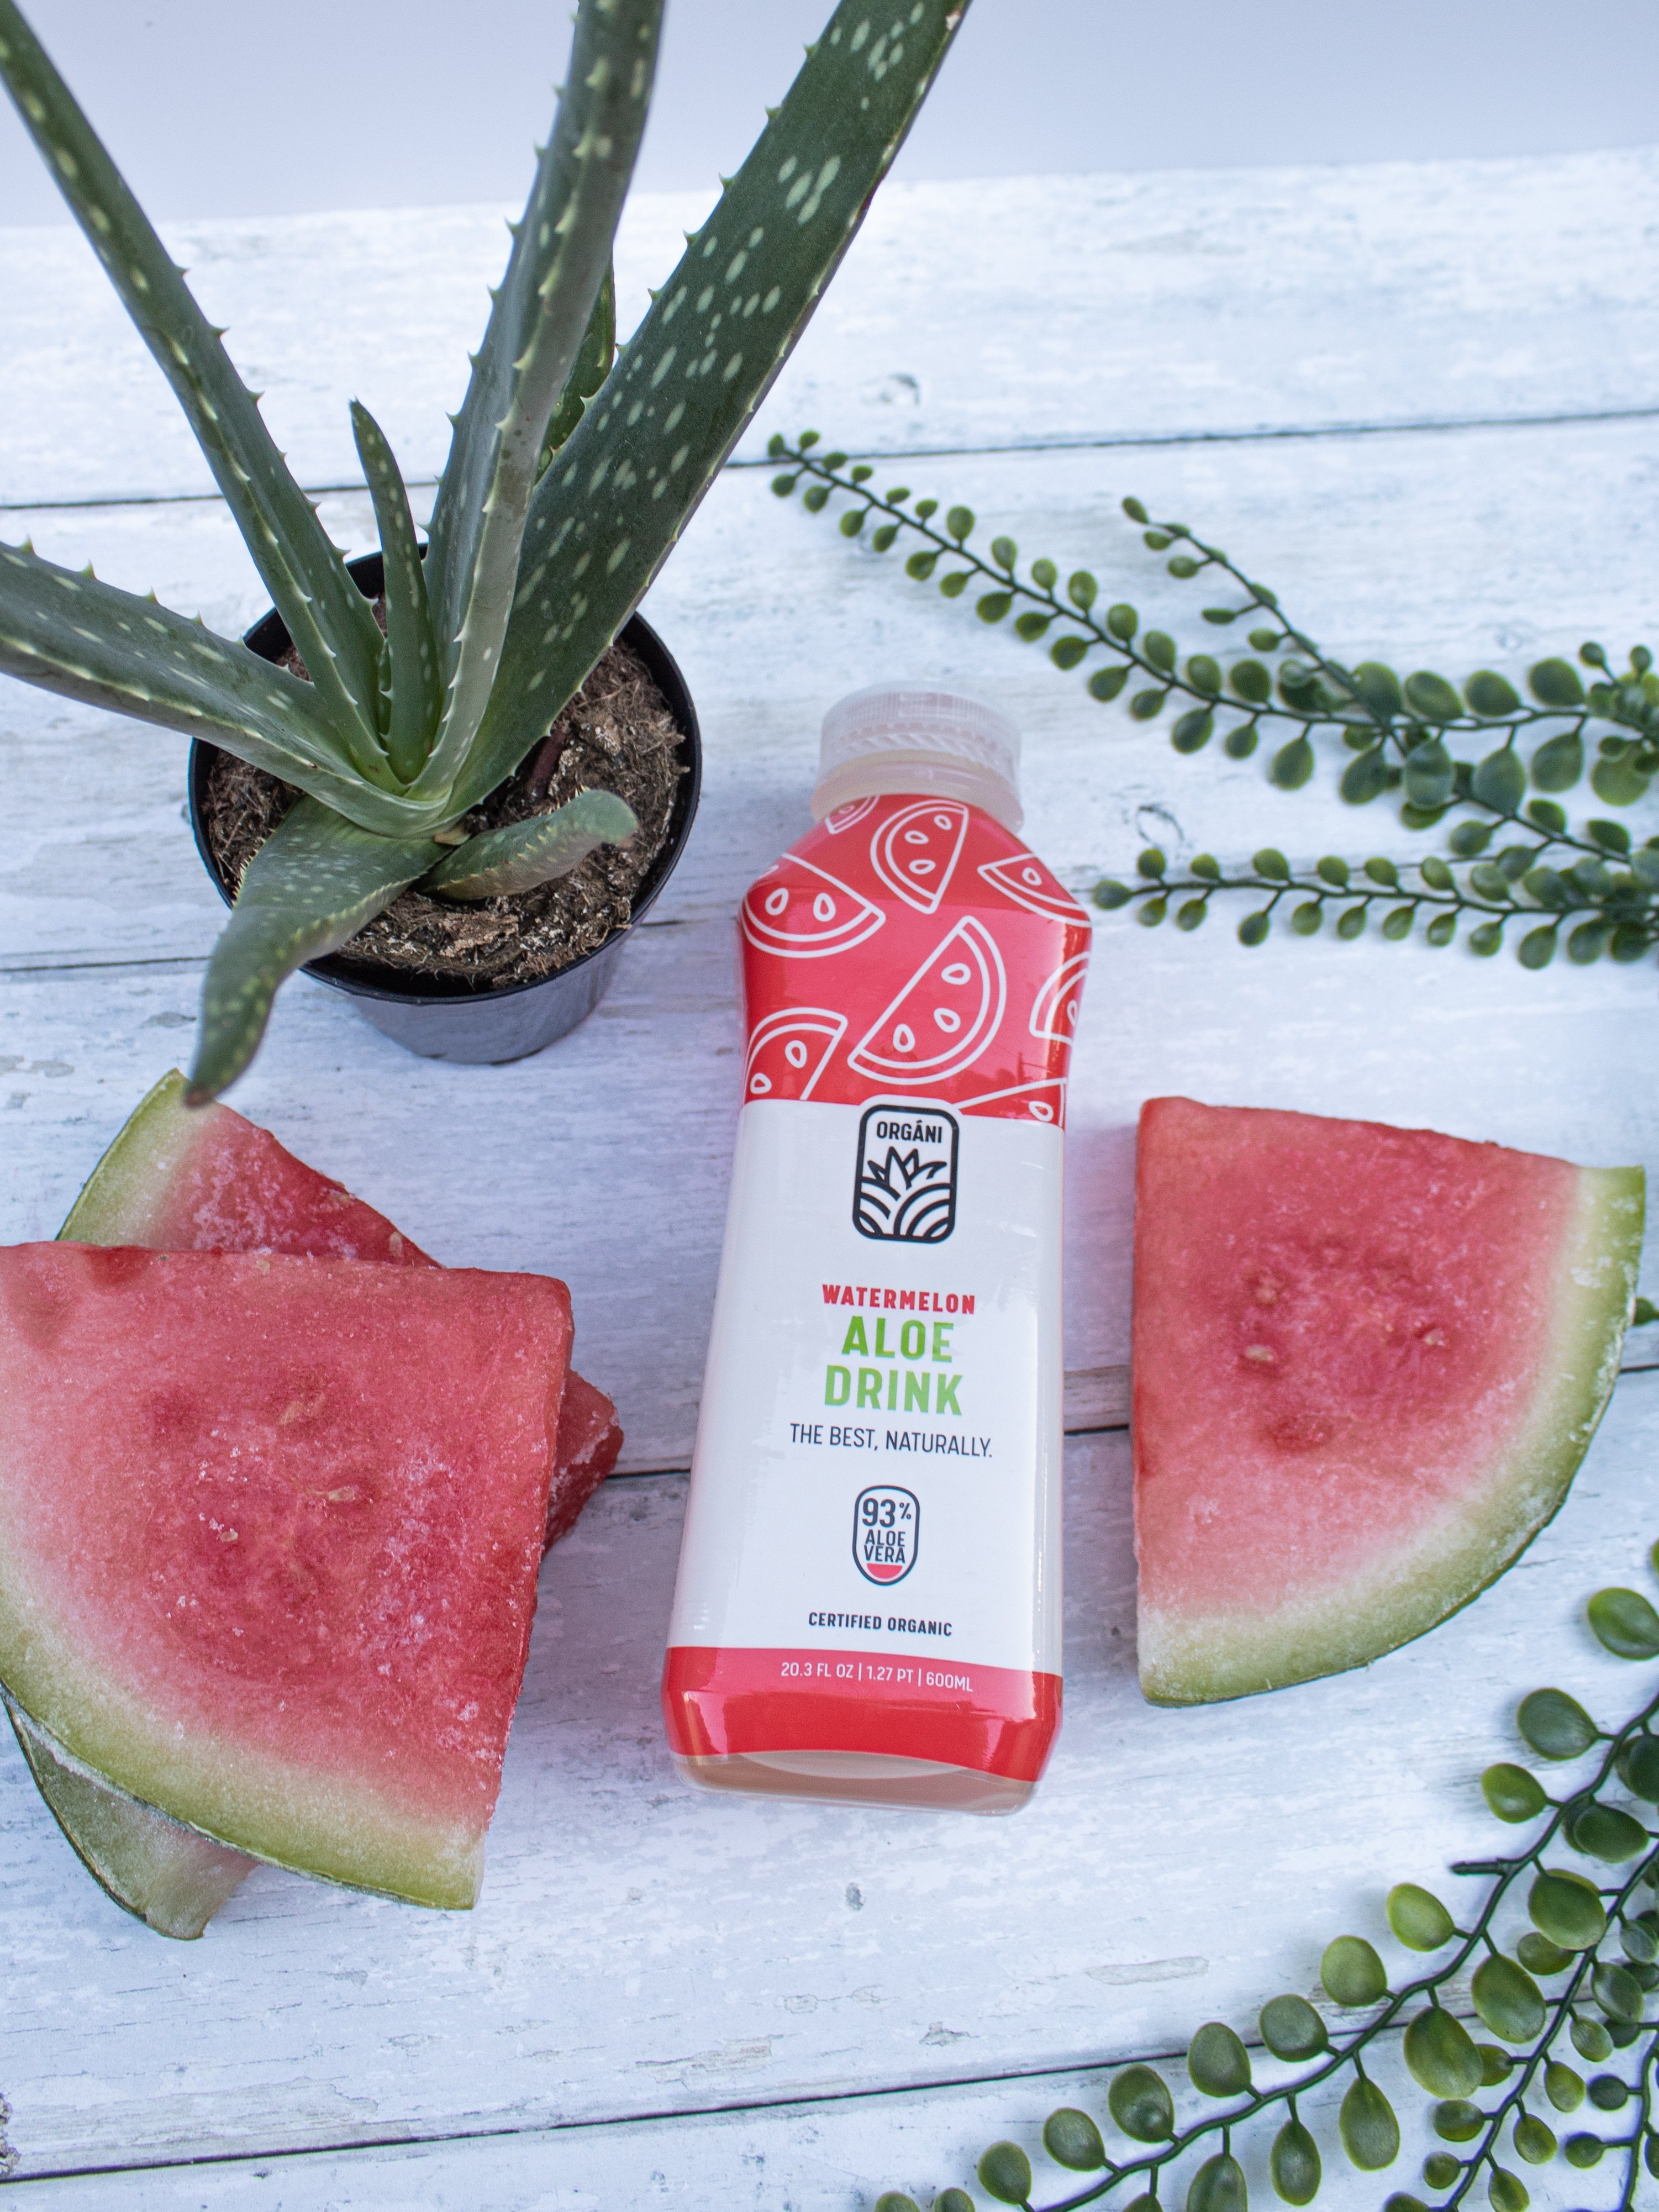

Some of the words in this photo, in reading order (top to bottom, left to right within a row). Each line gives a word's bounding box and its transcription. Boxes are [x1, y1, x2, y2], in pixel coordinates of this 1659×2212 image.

[876, 1120, 942, 1144] ORGÁNI
[822, 1283, 975, 1315] WATERMELON
[841, 1315, 954, 1363] ALOE
[824, 1365, 963, 1416] DRINK
[790, 1423, 823, 1445] THE
[830, 1426, 878, 1451] BEST,
[886, 1430, 993, 1458] NATURALLY.
[862, 1498, 912, 1528] 93%
[865, 1529, 905, 1547] ALOE
[864, 1545, 905, 1563] VERA
[808, 1612, 882, 1630] CERTIFIED
[887, 1617, 952, 1636] ORGANIC
[781, 1662, 812, 1677] 20.3
[817, 1663, 831, 1677] FL
[836, 1663, 854, 1678] OZ
[866, 1666, 893, 1681] 1.27
[897, 1669, 914, 1683] PT
[926, 1671, 973, 1692] 600ML
